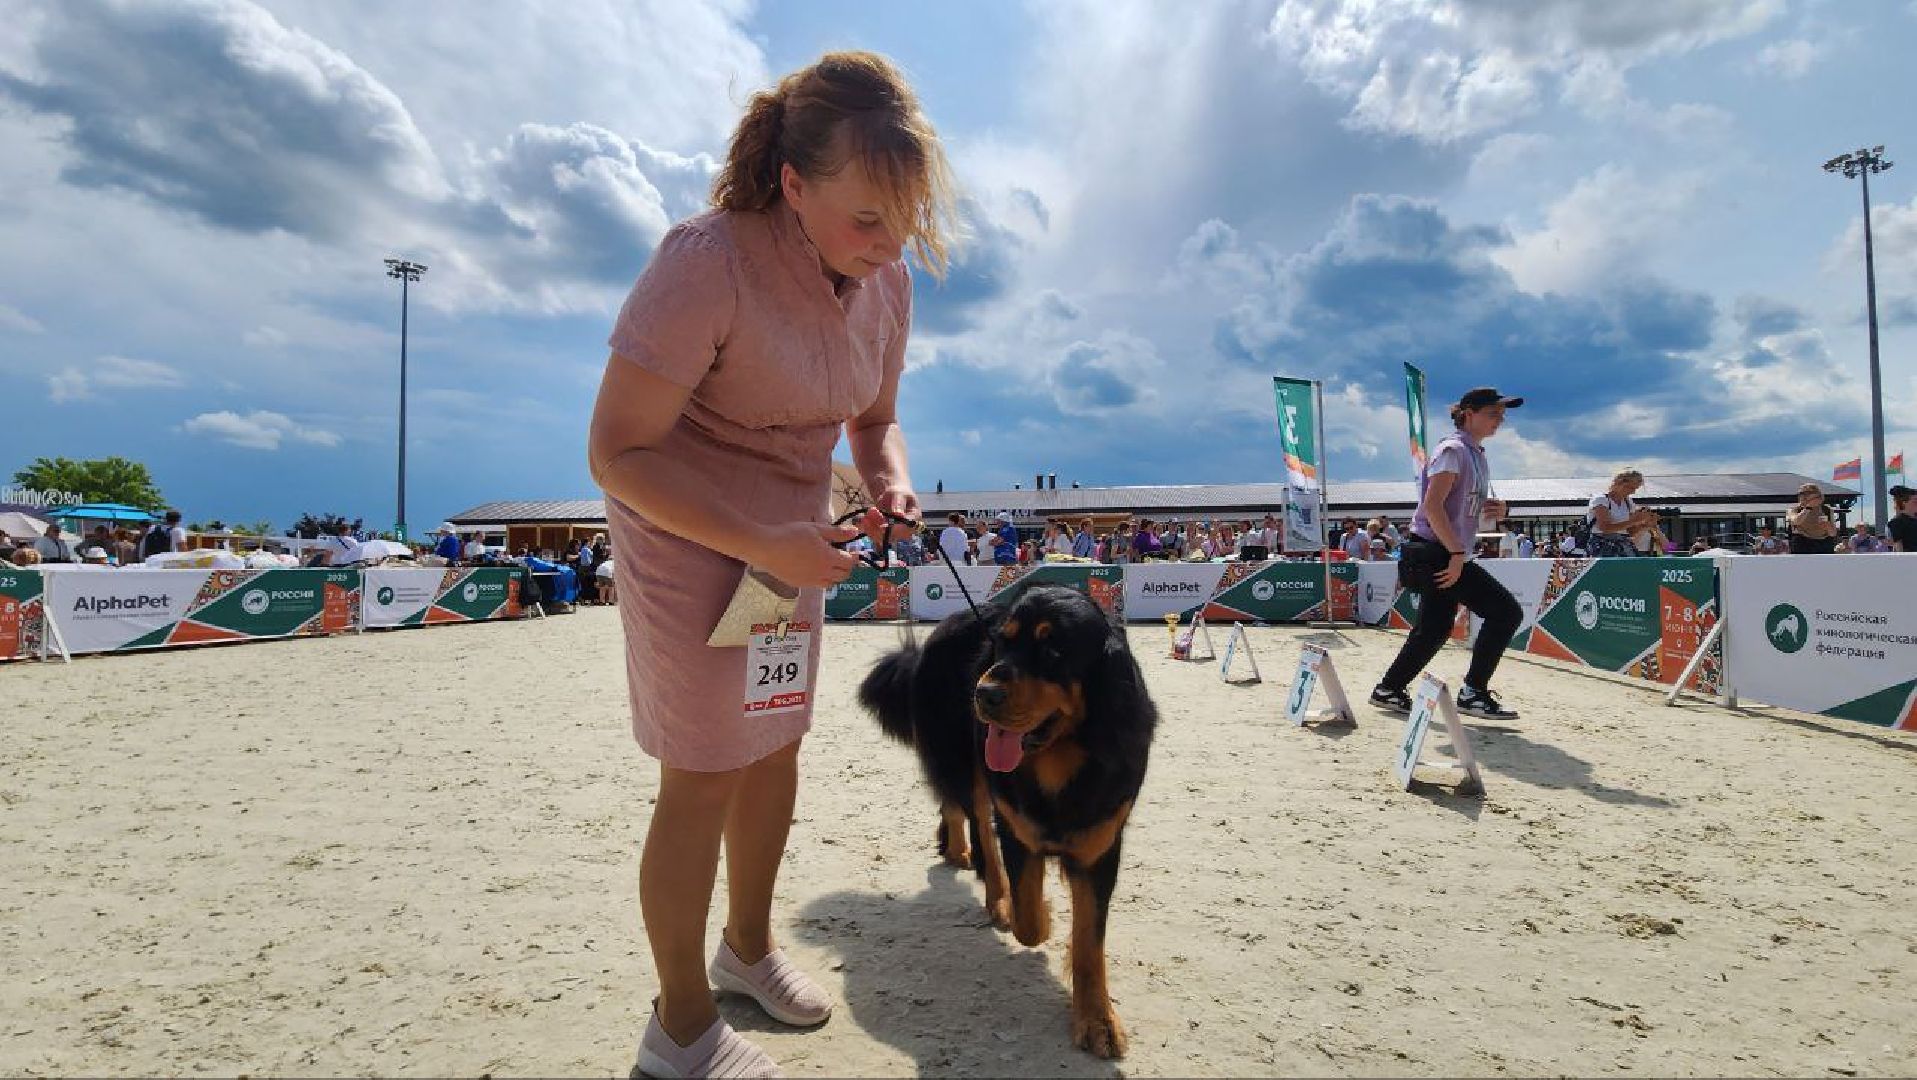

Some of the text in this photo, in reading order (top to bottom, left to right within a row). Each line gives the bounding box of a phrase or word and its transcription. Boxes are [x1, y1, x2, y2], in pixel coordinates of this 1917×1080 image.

[1662, 569, 1693, 583] 2025
[1141, 580, 1201, 594] AlphaPet
[1275, 581, 1314, 590] РОССИЯ
[271, 590, 314, 600] РОССИЯ
[73, 593, 171, 614] AlphaPet
[1600, 596, 1645, 613] РОССИЯ
[1815, 609, 1888, 625] Российская
[1815, 628, 1917, 645] кинологическая
[757, 662, 799, 686] 249
[1291, 670, 1311, 715] 3
